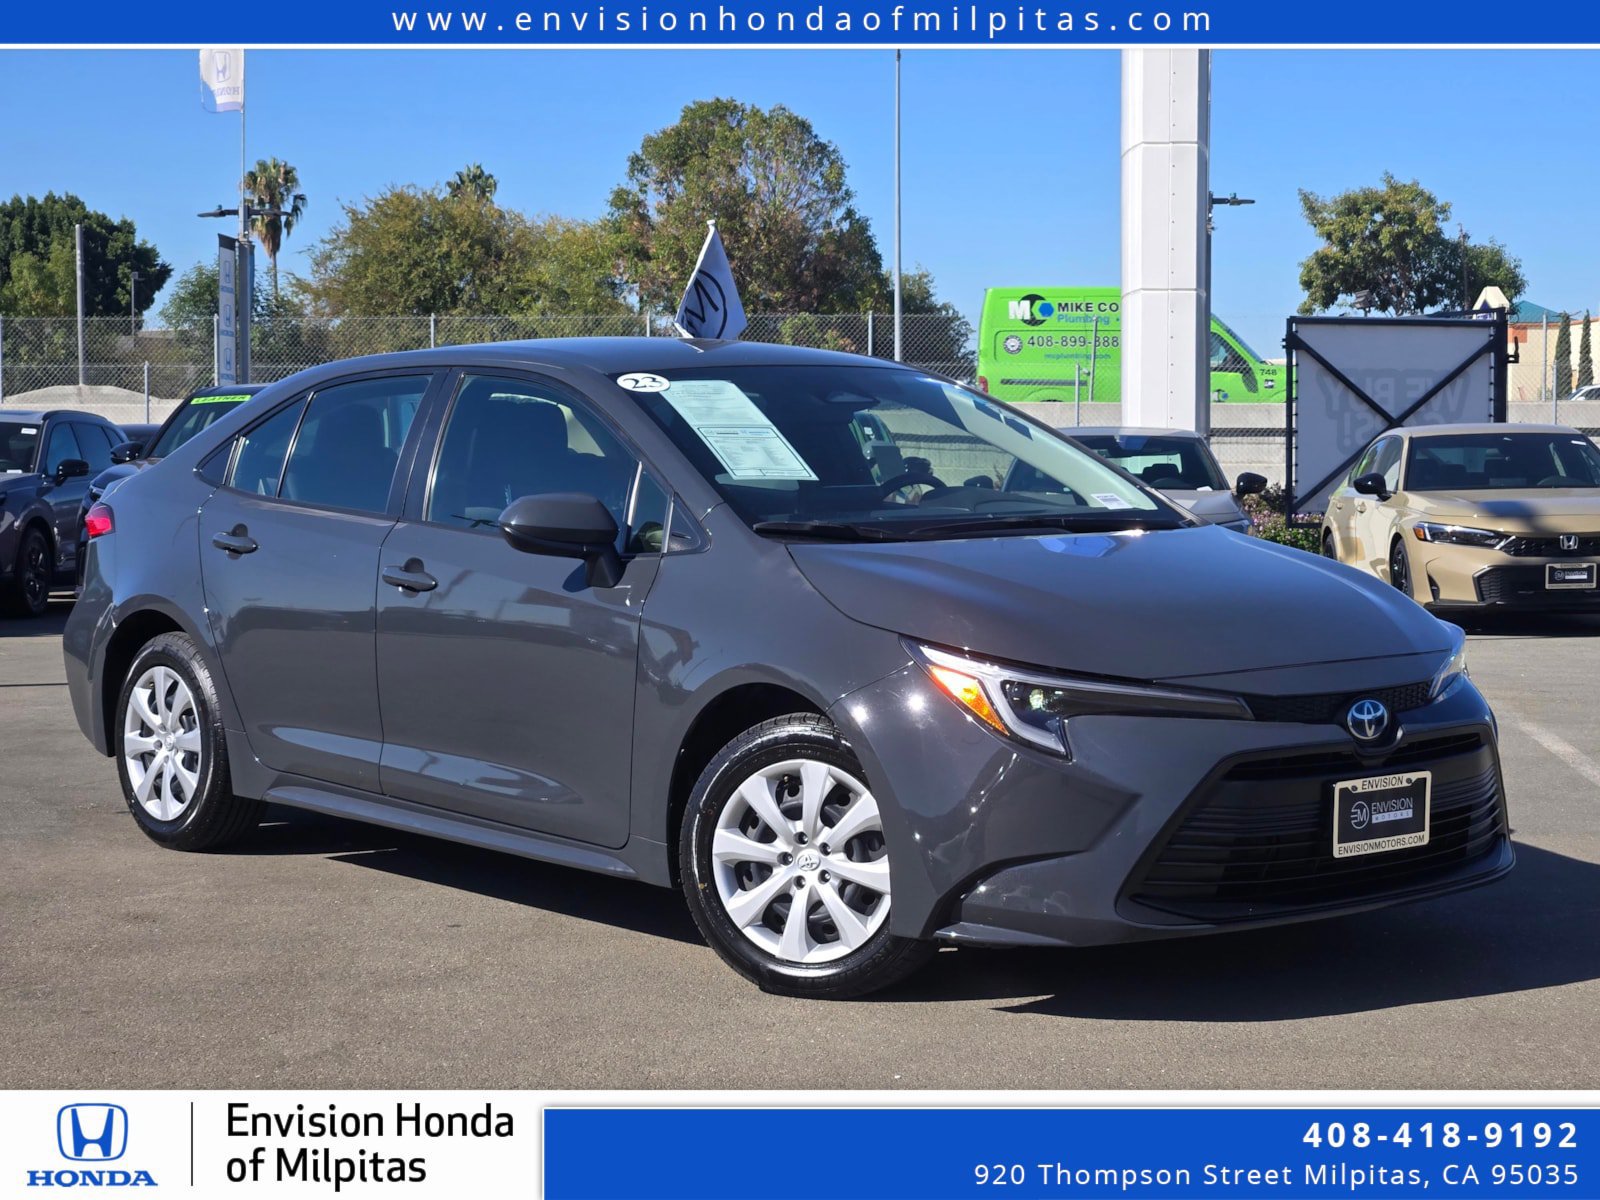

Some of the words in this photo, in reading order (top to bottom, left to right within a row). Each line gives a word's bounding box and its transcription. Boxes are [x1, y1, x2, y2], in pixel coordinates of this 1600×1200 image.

[1057, 302, 1094, 313] MIKE
[1260, 368, 1277, 376] 748
[623, 376, 662, 389] 23
[1361, 775, 1404, 791] ENVISION
[1371, 797, 1413, 814] ENVISION
[1338, 834, 1425, 856] ENVISIONMOTORS.COM
